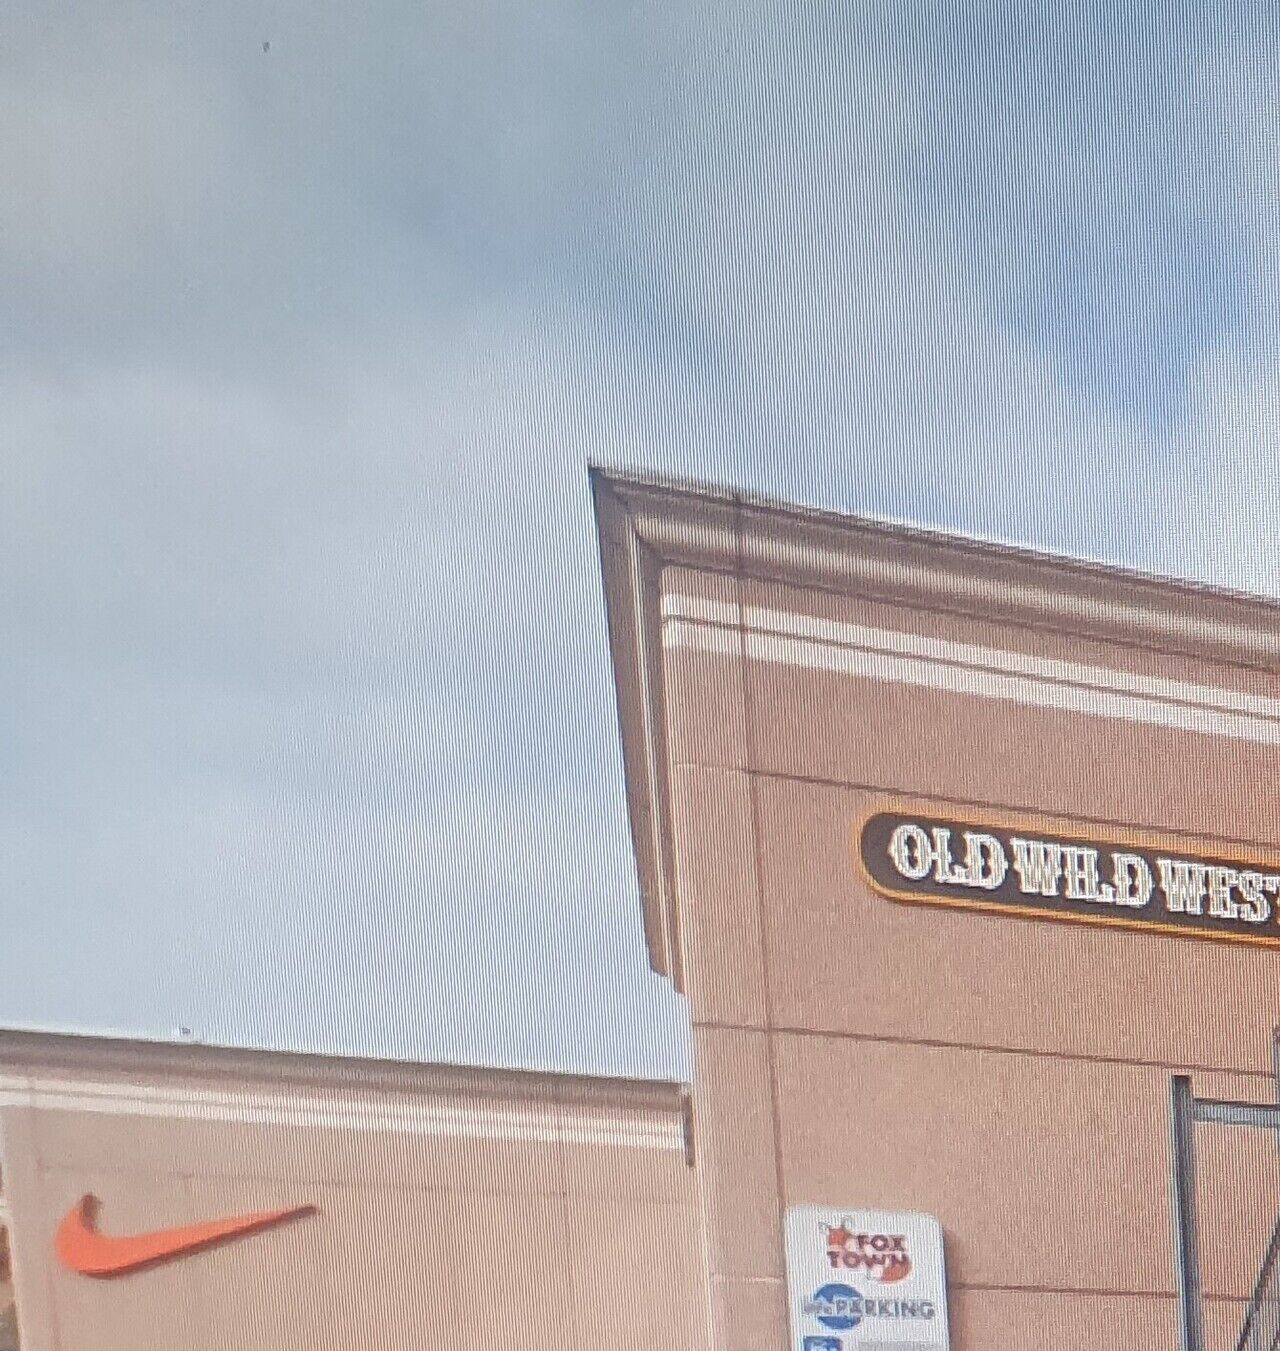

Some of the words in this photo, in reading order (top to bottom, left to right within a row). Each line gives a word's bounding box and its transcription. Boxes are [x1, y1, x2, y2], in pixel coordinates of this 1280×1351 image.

[887, 822, 1008, 891] OLD
[1009, 836, 1155, 908] WILD
[856, 1233, 907, 1252] FOX
[826, 1250, 909, 1270] TOWN
[835, 1297, 935, 1320] PARKING
